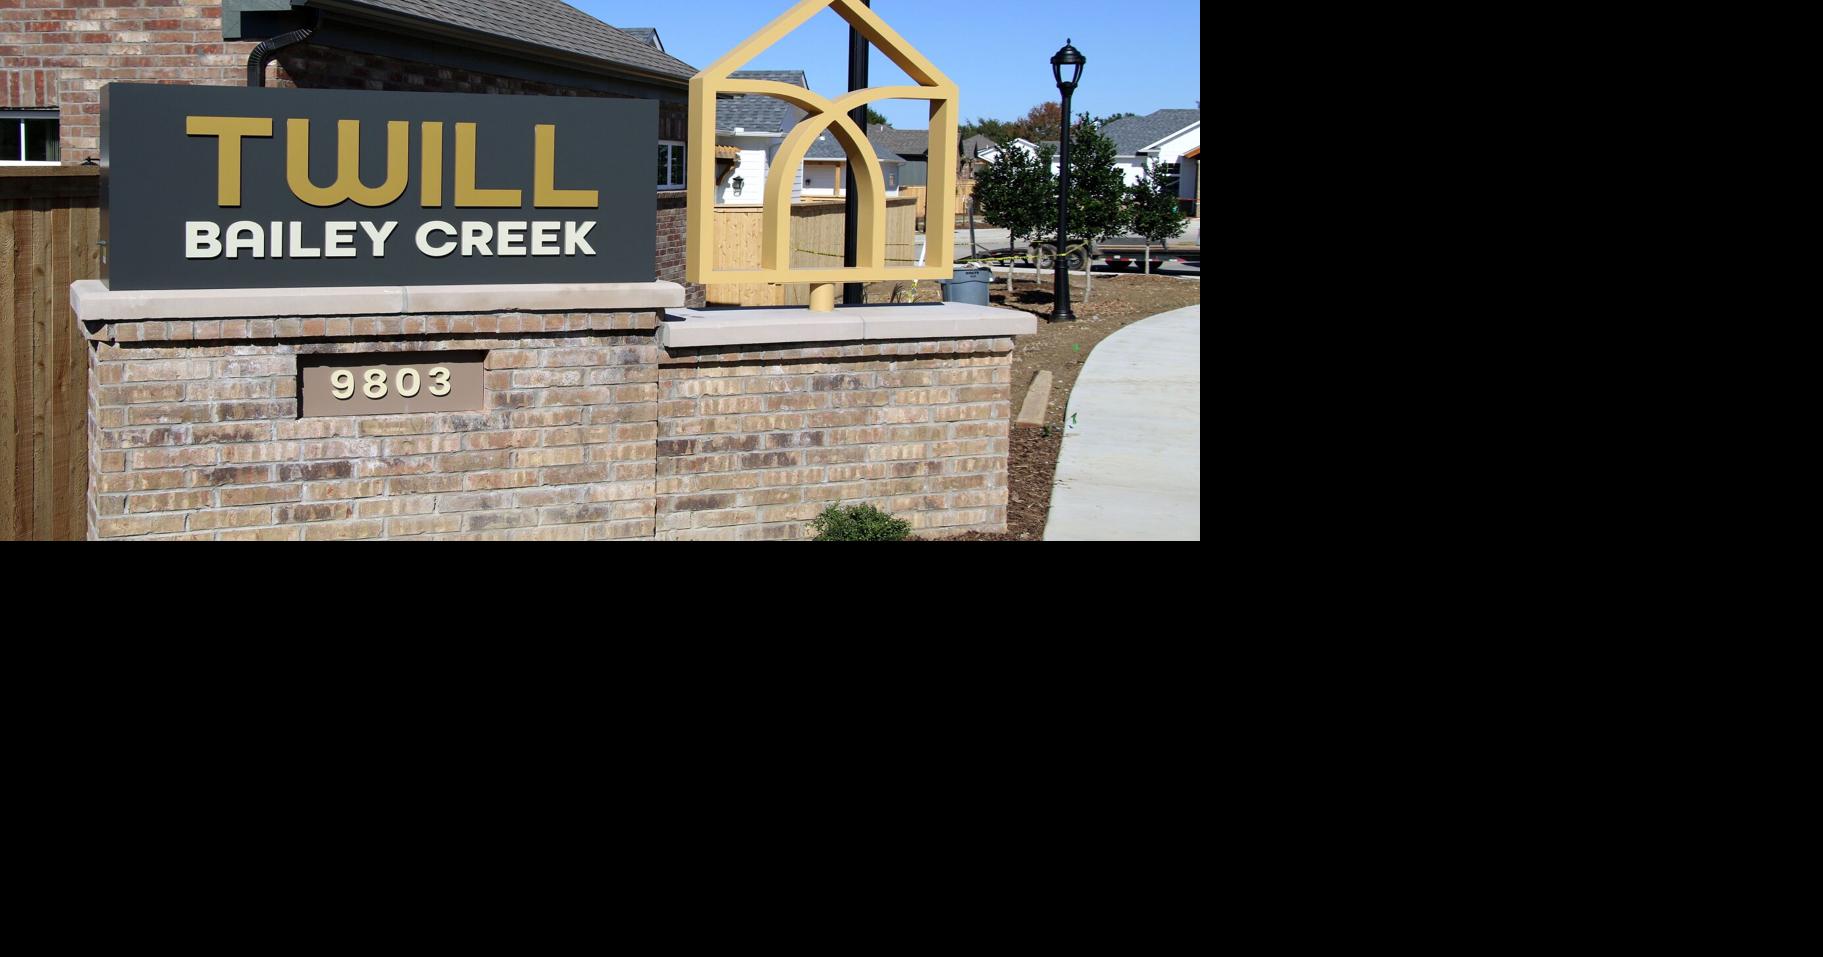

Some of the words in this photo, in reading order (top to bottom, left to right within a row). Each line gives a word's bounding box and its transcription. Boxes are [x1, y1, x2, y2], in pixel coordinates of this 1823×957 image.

[186, 115, 599, 208] TWILL
[185, 220, 399, 259] BAILEY
[414, 220, 597, 257] CREEK
[330, 366, 453, 399] 9803
